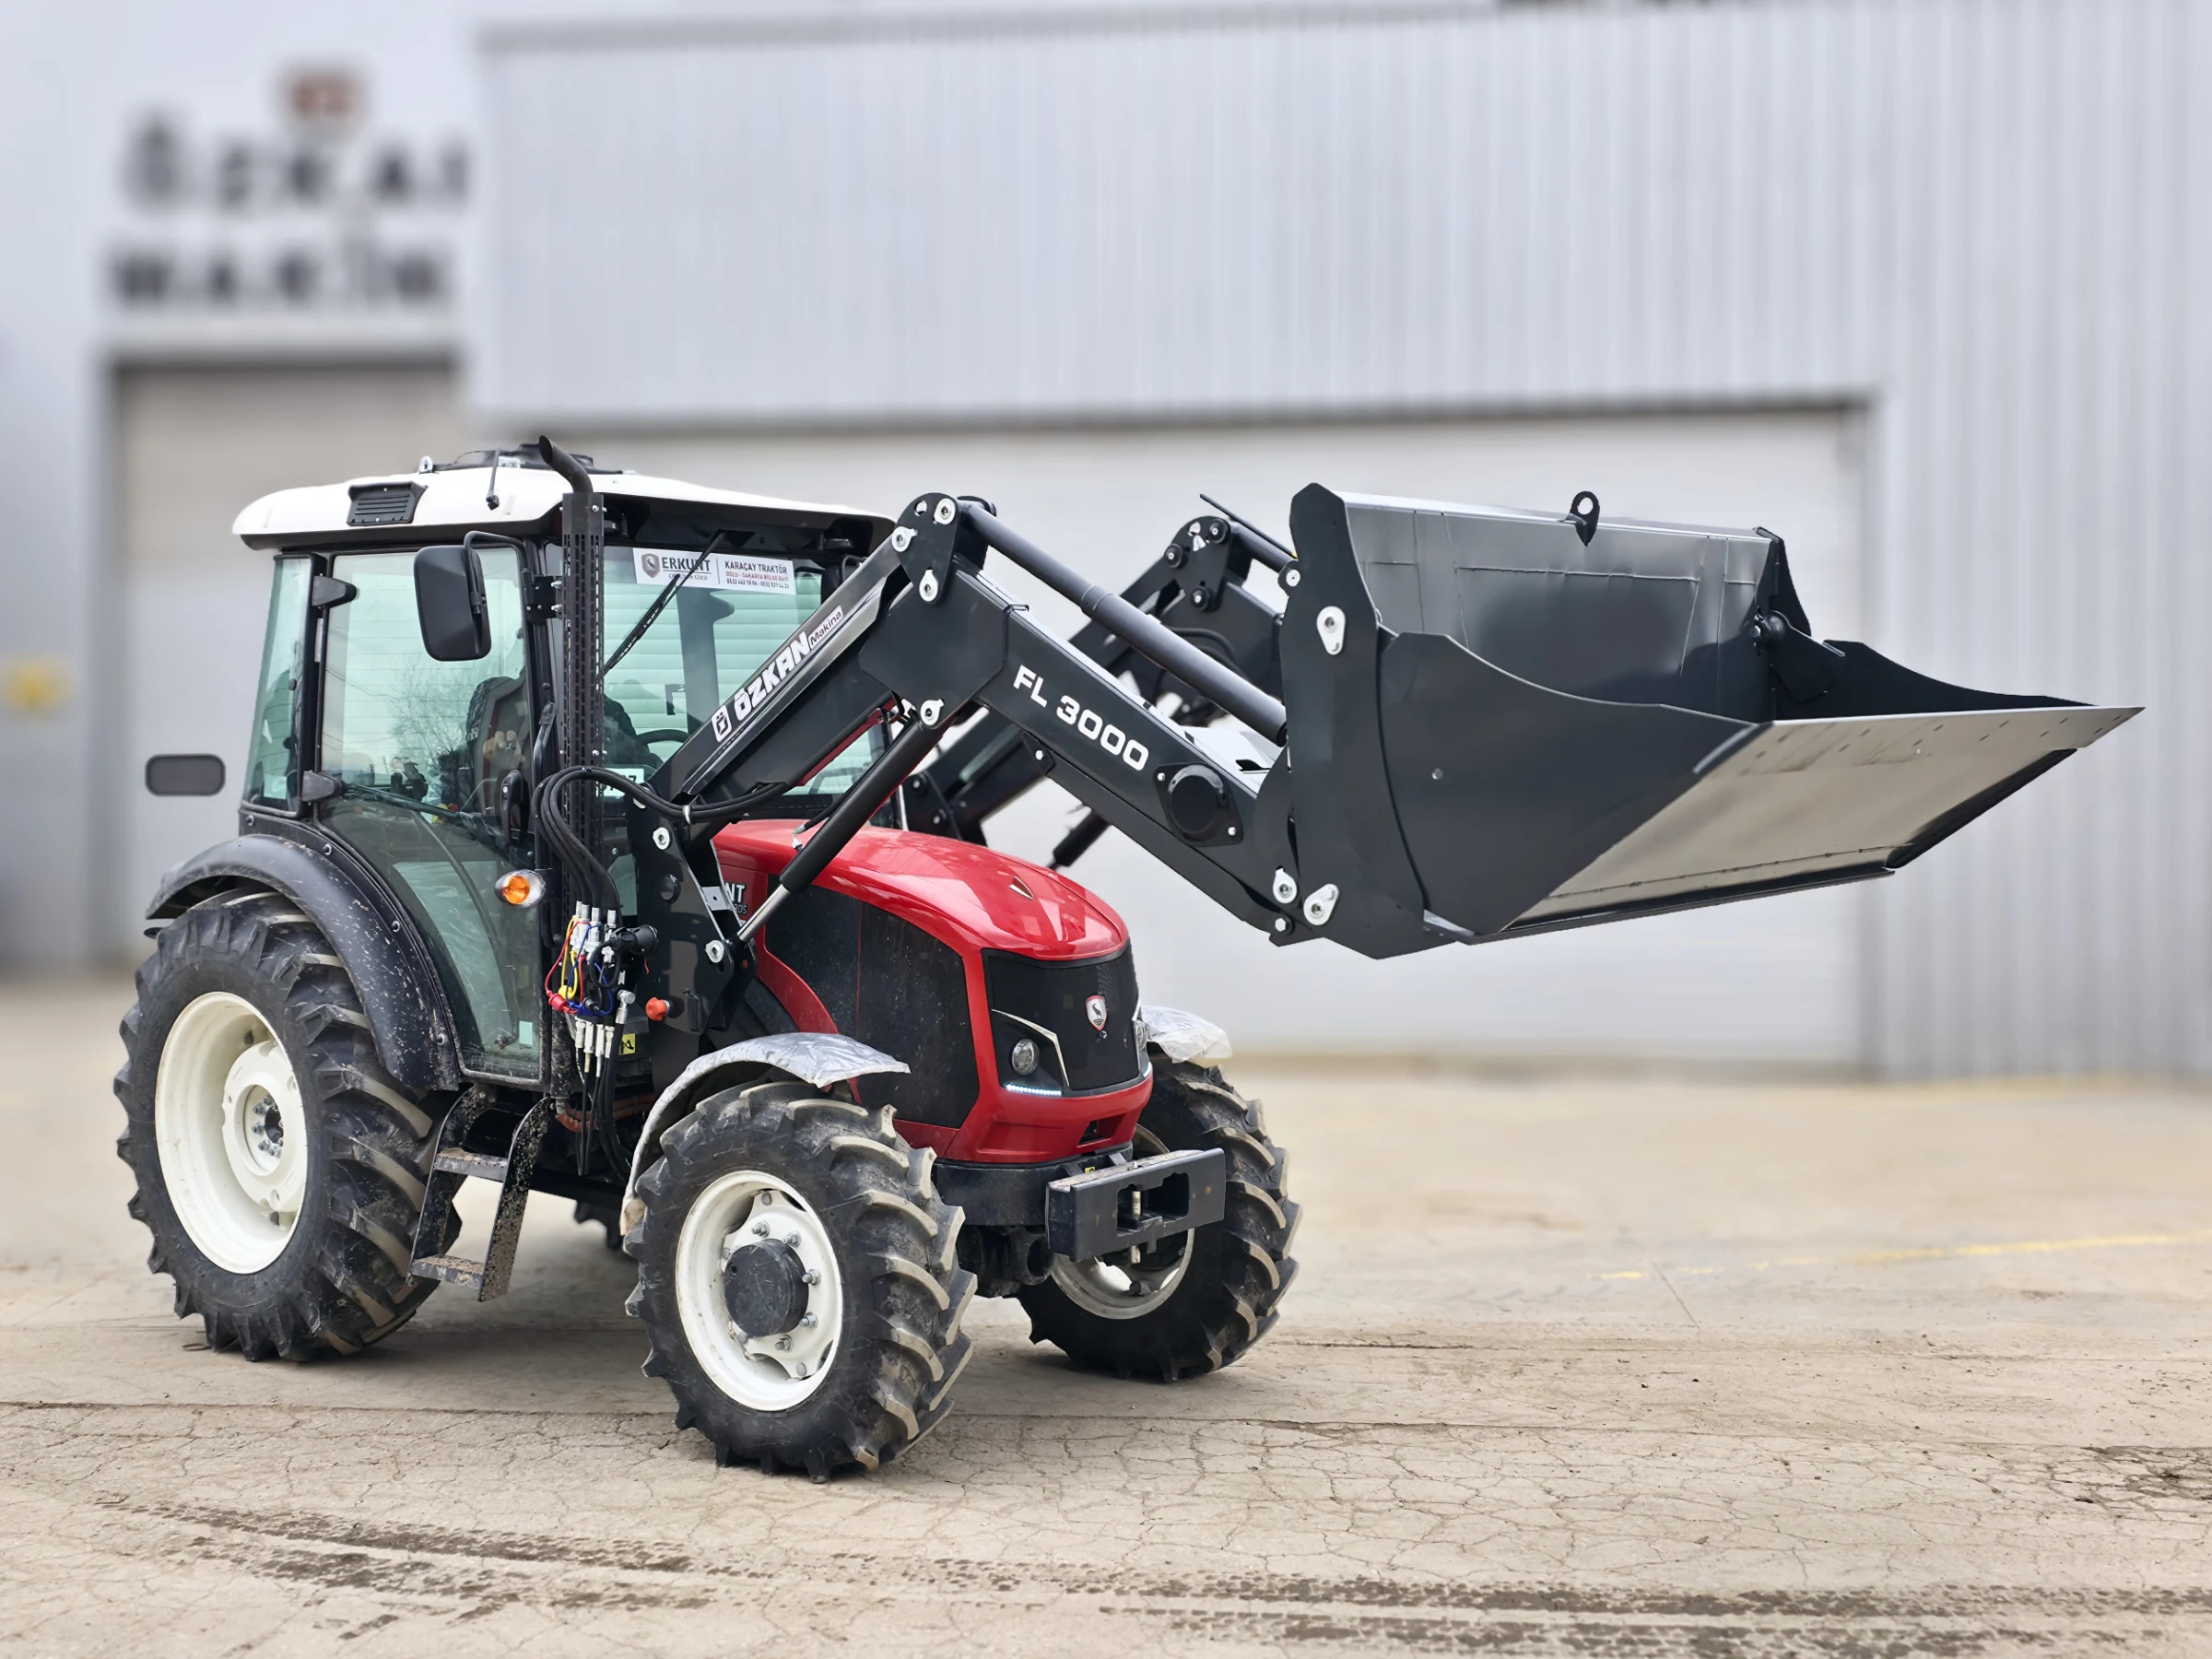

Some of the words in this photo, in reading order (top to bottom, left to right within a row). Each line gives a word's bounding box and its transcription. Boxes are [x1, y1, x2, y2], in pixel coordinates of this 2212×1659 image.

[661, 557, 711, 571] ERKUNT
[724, 560, 756, 571] KARAÇAY
[758, 563, 787, 574] TRAKTÖR
[734, 630, 811, 722] ÖZKAN
[809, 610, 842, 647] Makina
[1013, 665, 1048, 708] FL
[1055, 695, 1149, 771] 3000
